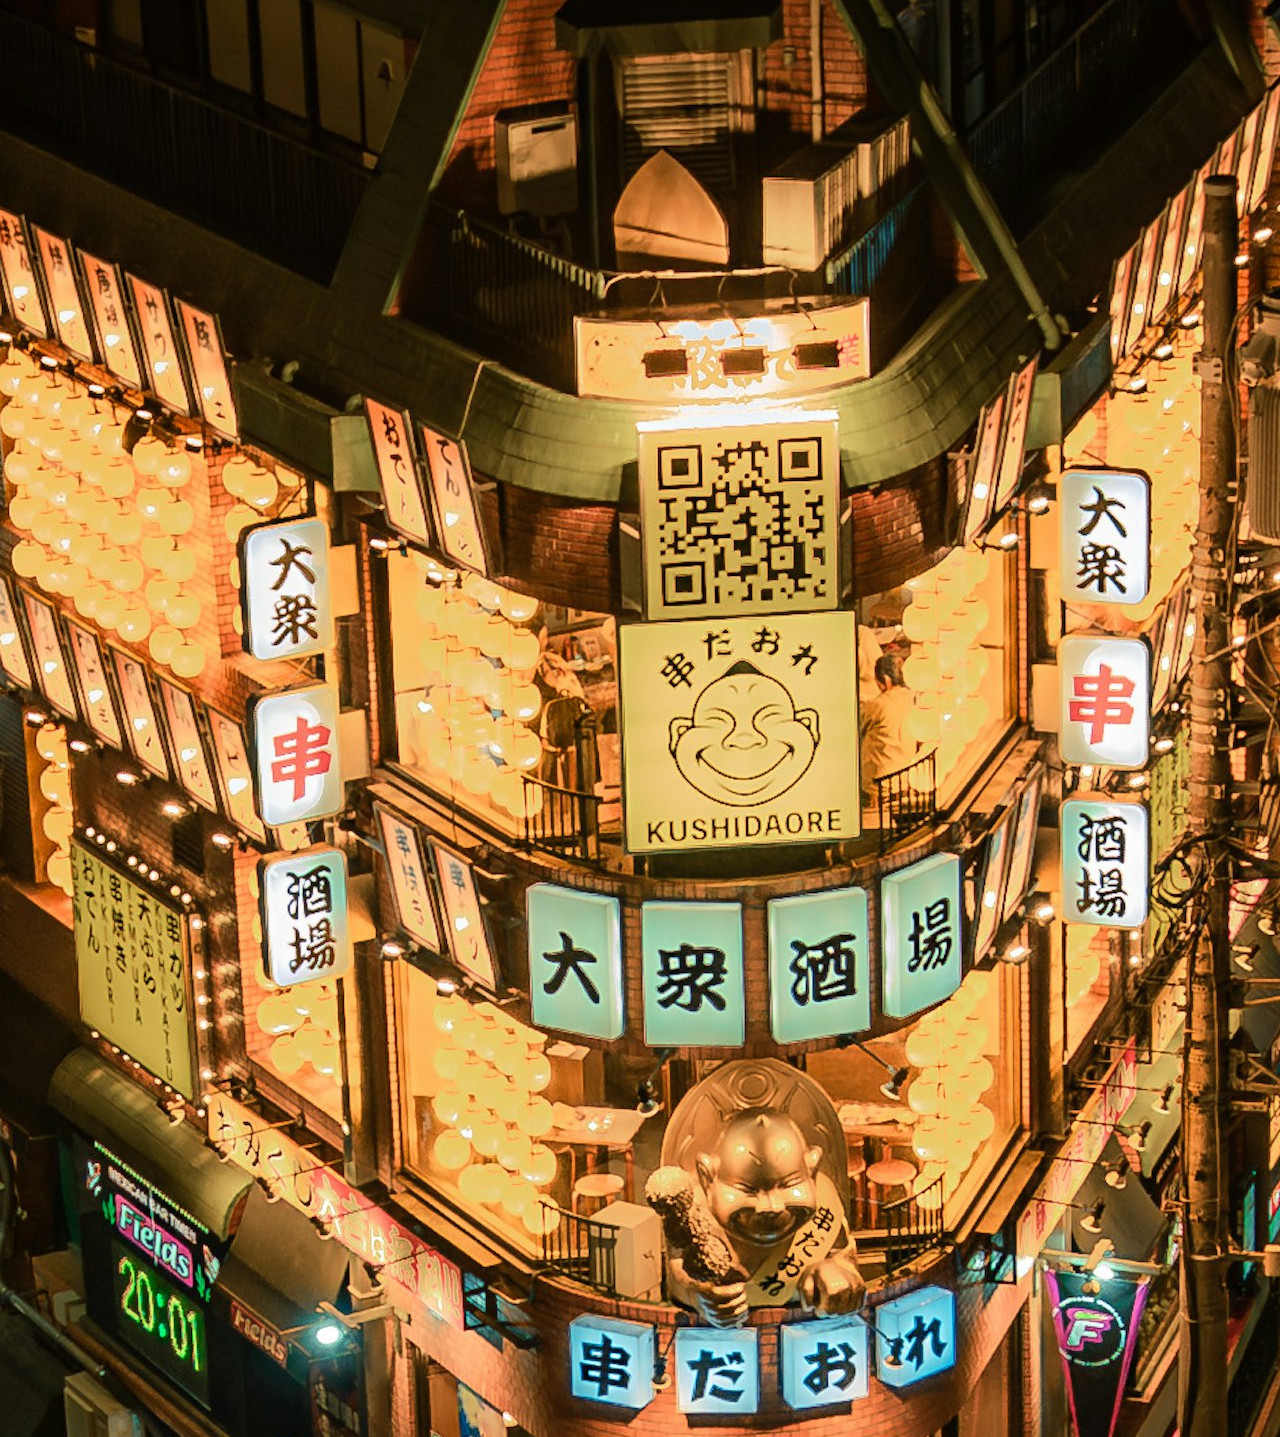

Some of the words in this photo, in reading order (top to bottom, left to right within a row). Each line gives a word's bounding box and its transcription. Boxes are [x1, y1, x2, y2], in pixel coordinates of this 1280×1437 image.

[1077, 485, 1128, 596] 大衆
[269, 539, 319, 647] 大衆
[659, 625, 820, 691] 串だおれ
[1067, 663, 1137, 747] 串
[270, 716, 332, 803] 串
[646, 809, 843, 844] KUSHIDAORE
[1076, 813, 1128, 919] 酒場
[286, 866, 337, 974] 酒場
[119, 1201, 191, 1279] Fields
[759, 1206, 835, 1297] 串だおれ
[119, 1255, 200, 1372] 20:01
[233, 1308, 285, 1361] Fields
